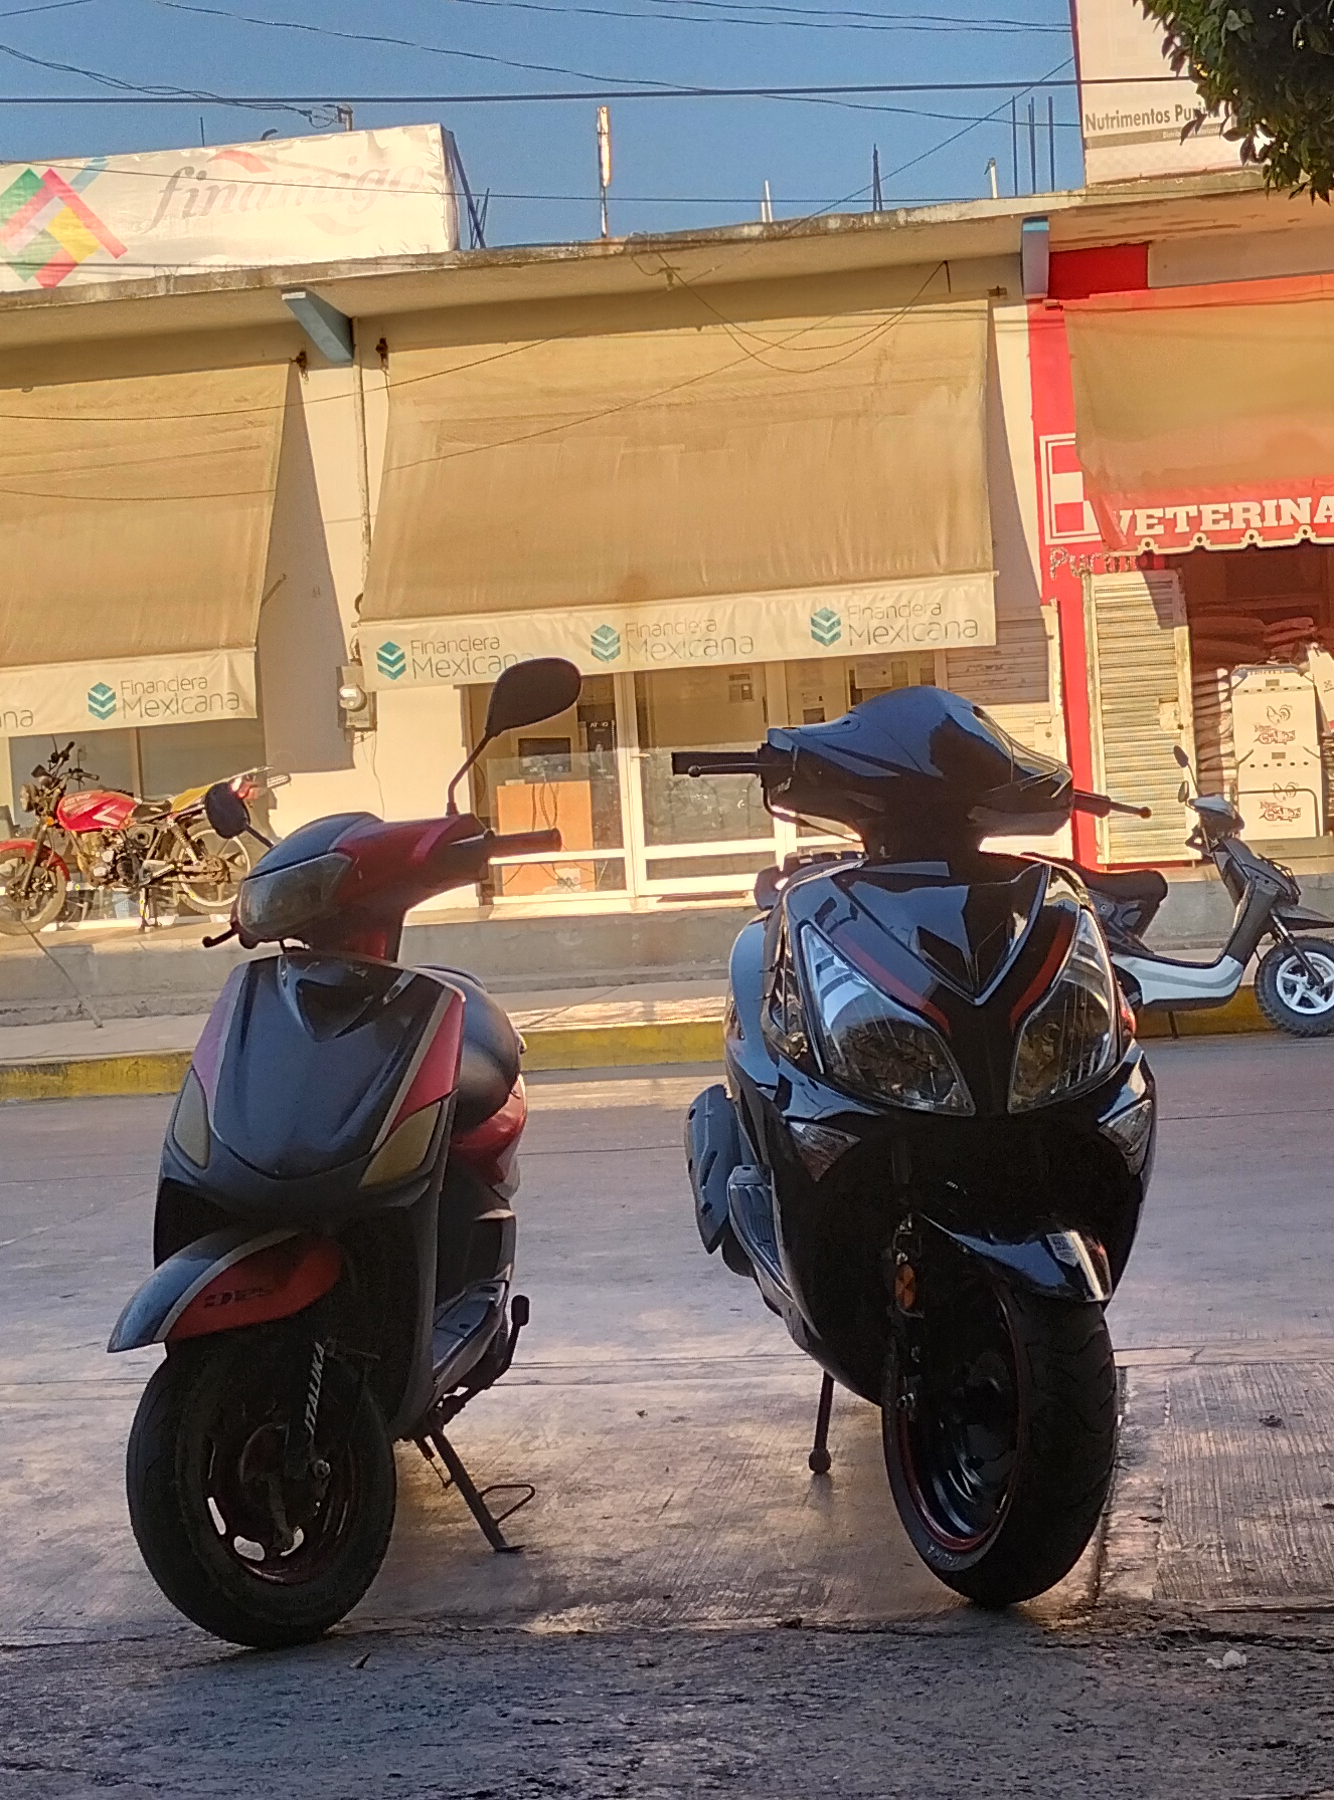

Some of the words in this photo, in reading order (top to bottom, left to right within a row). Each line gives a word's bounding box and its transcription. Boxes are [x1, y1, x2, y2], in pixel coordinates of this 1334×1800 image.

[1085, 107, 1170, 132] Nutrimentos
[625, 618, 717, 638] Financiera
[848, 619, 979, 646] Mexicana
[410, 636, 500, 656] Financiera
[626, 635, 754, 663] Mexicana
[120, 676, 208, 696] Financiera
[122, 692, 240, 719] Mexicana
